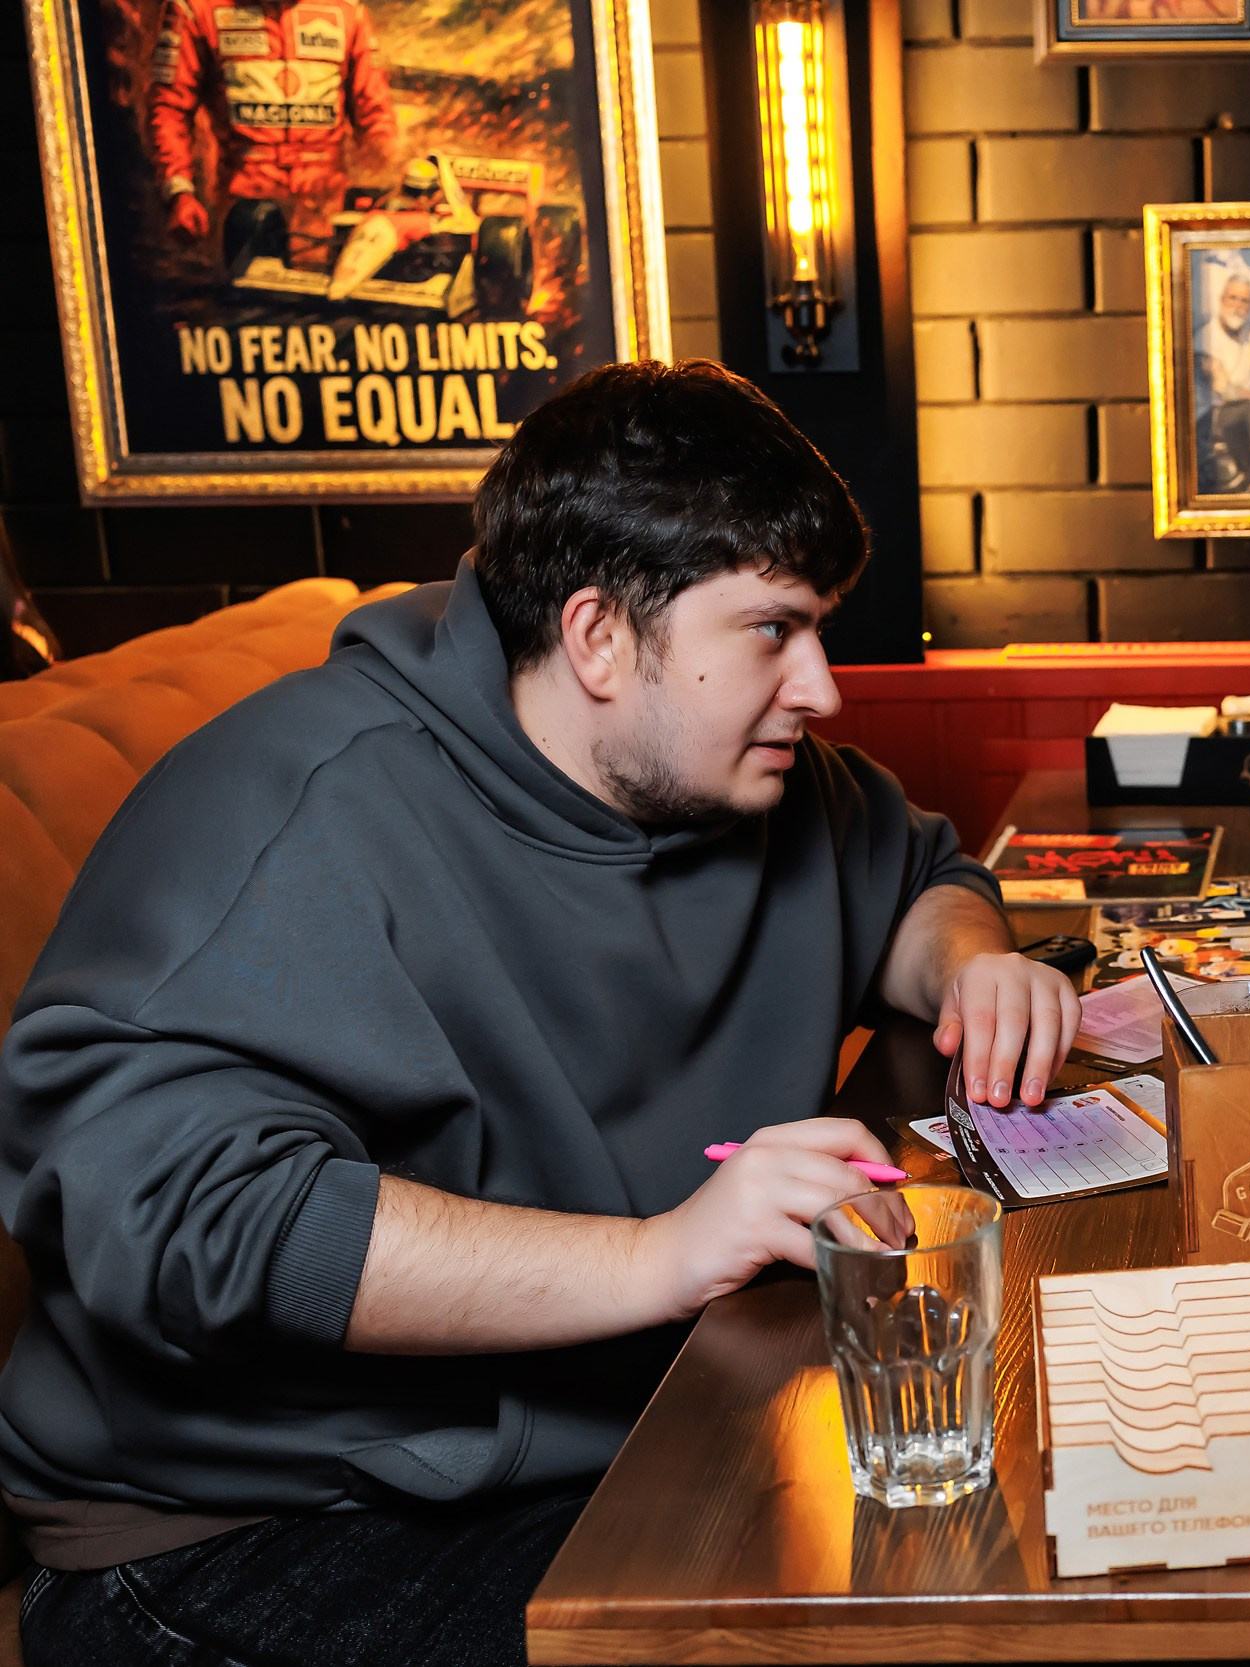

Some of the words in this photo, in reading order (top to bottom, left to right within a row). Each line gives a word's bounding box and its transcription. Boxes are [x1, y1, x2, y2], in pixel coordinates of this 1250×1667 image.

[178, 325, 233, 375] NO
[239, 324, 350, 374] FEAR.
[353, 323, 410, 372] NO
[415, 320, 559, 371] LIMITS.
[218, 374, 304, 444] NO
[318, 372, 522, 448] EQUAL
[1087, 1499, 1154, 1518] МЕСТО
[1157, 1495, 1198, 1513] ДЛЯ
[1087, 1520, 1166, 1539] ВАШЕГО
